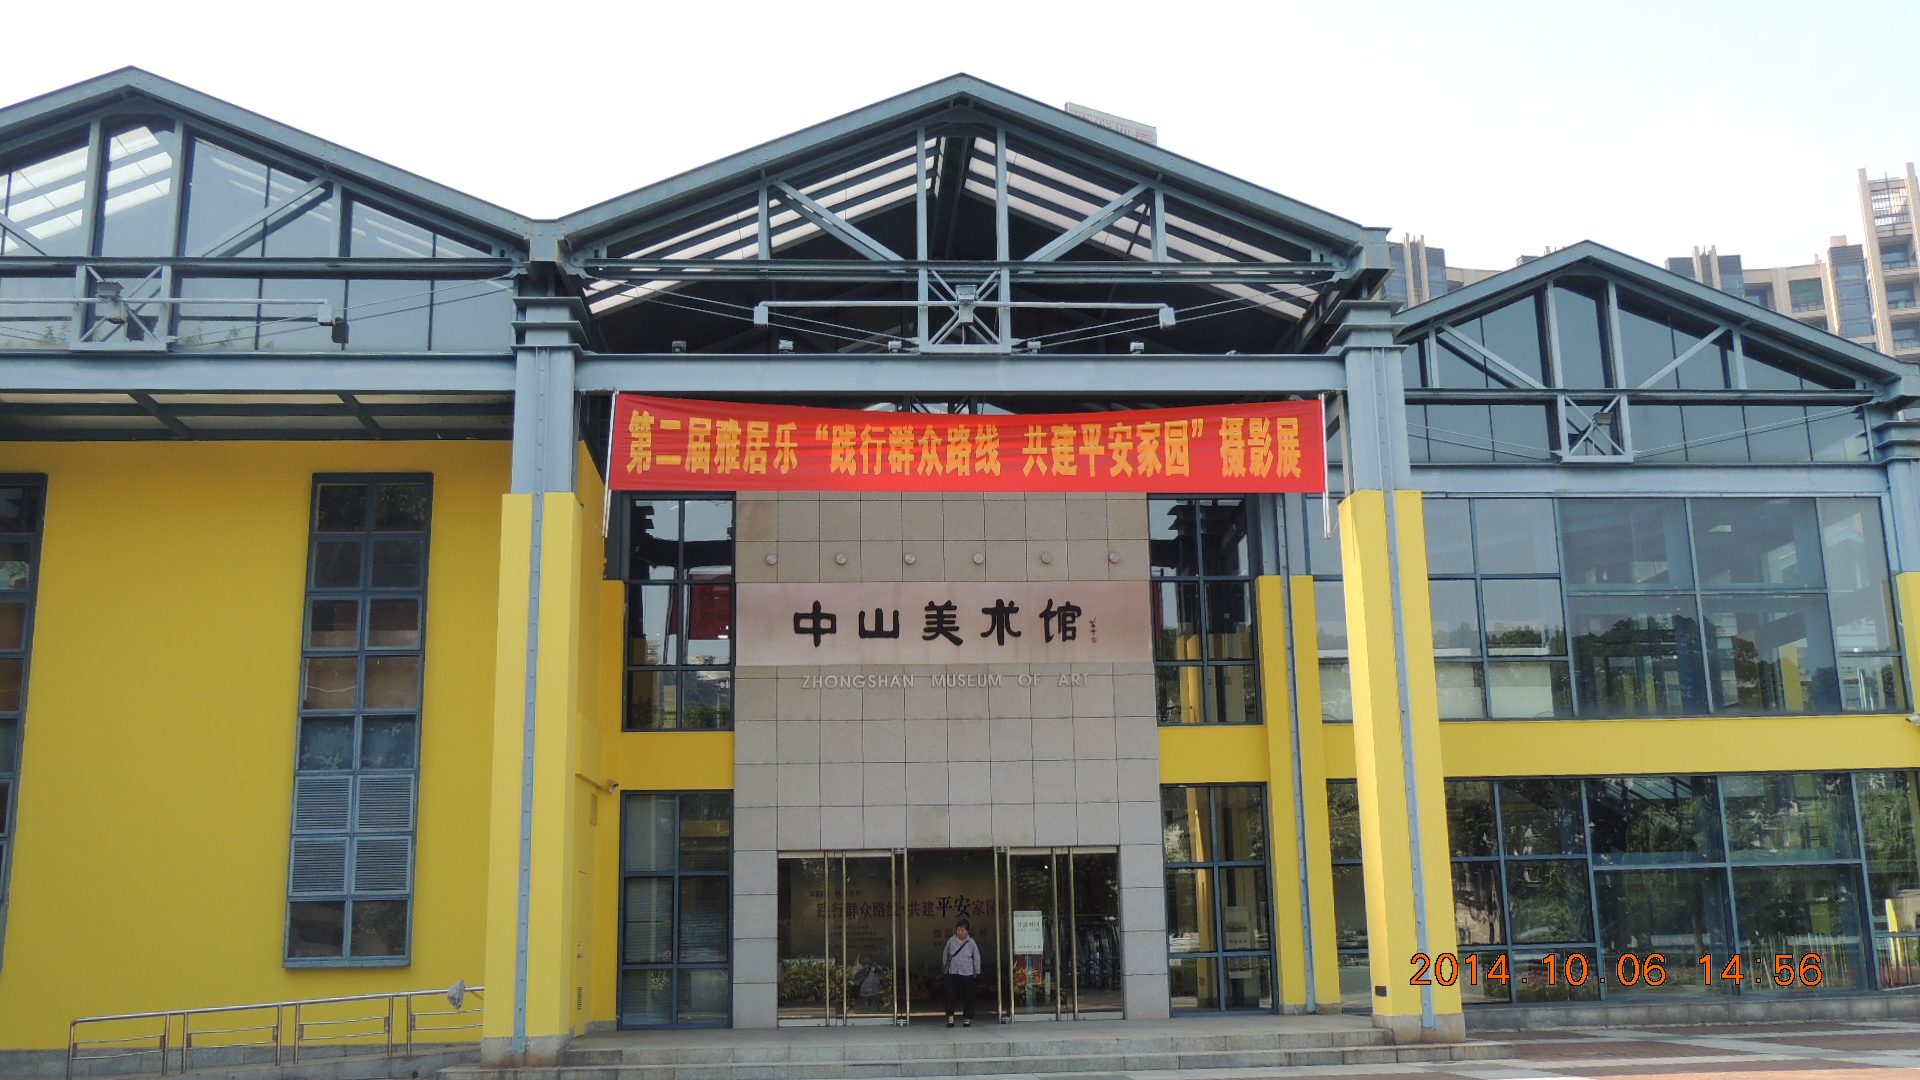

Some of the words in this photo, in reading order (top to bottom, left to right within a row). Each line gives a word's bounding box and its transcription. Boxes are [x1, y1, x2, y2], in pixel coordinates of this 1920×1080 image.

[627, 410, 798, 474] 第二届雅居乐
[1219, 416, 1301, 478] 摄影展
[793, 598, 1082, 647] 中山美术馆
[801, 674, 914, 689] ZHONGSHAN
[931, 673, 1002, 688] MUSEUM
[1018, 673, 1041, 687] OF
[1057, 672, 1089, 687] ART
